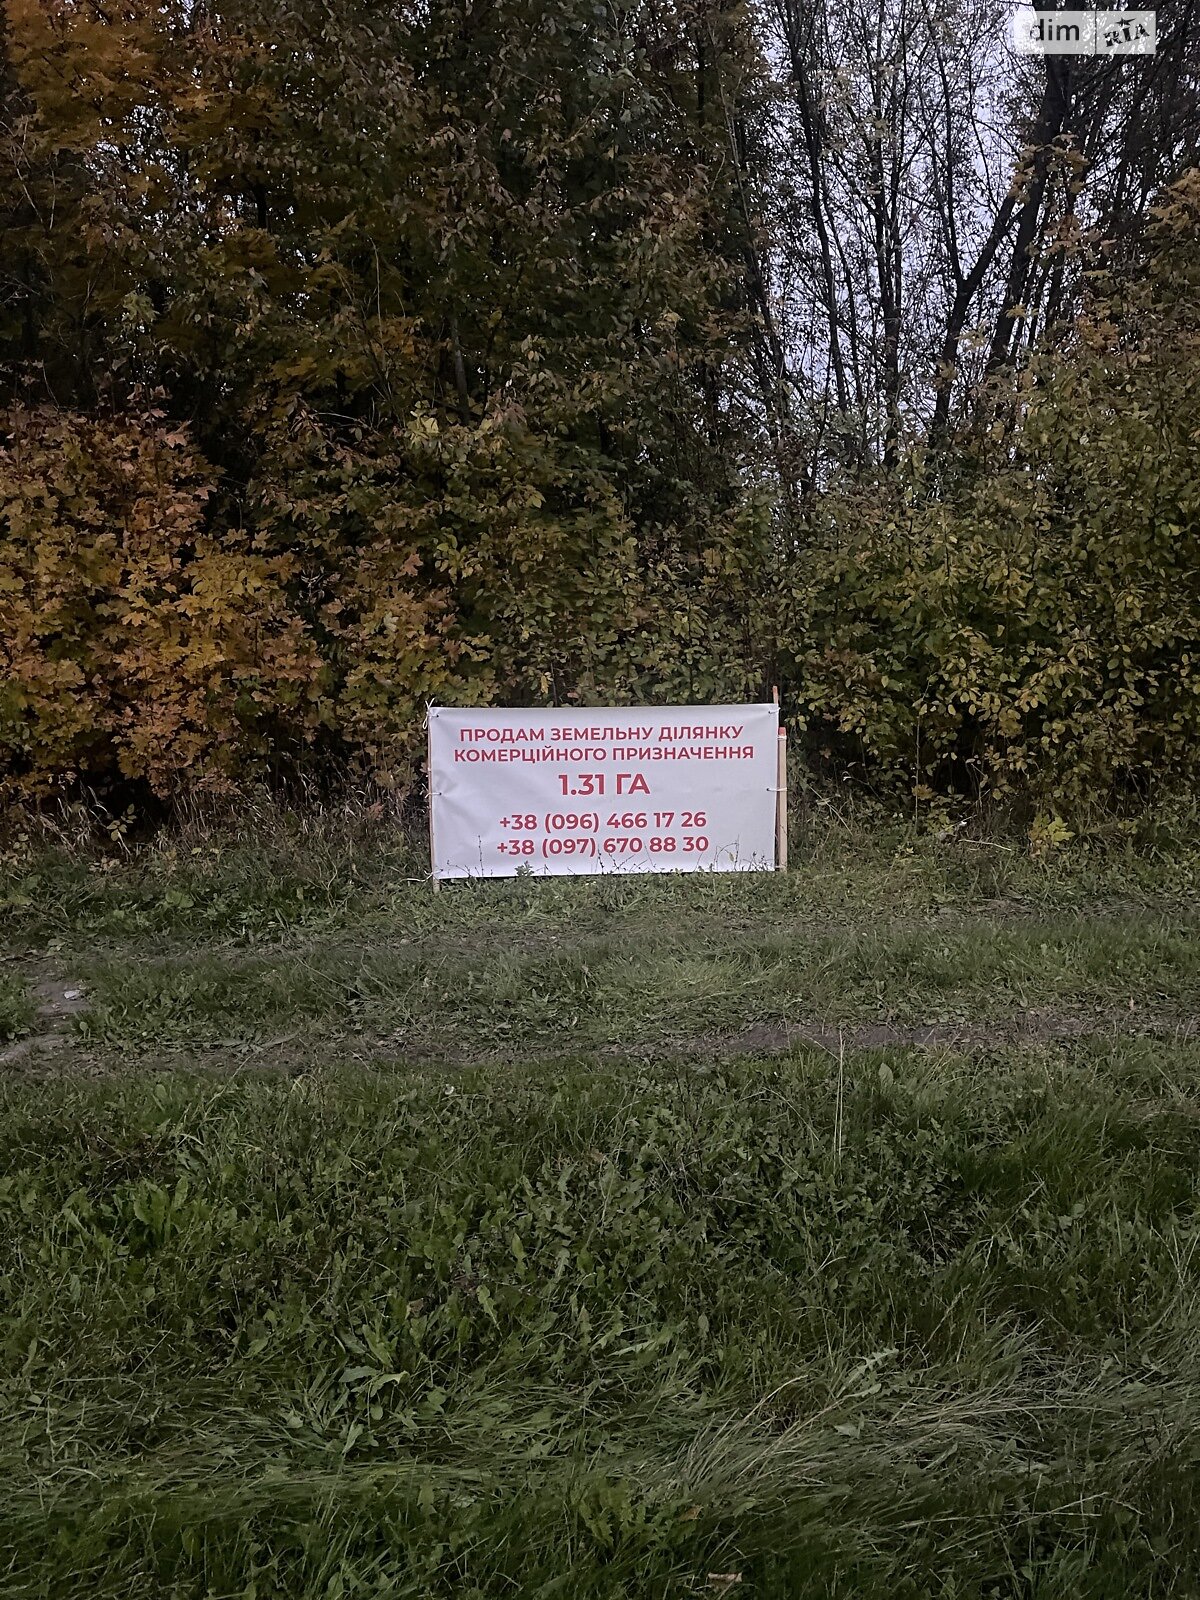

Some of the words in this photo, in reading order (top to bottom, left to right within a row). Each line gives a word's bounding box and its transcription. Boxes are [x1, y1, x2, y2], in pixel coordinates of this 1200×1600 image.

[459, 727, 545, 744] ПРОДАМ
[550, 726, 654, 742] ЗЕМЕЛЬНУ
[658, 725, 744, 743] ДІЛЯНКУ
[453, 745, 607, 764] КОМЕРЦІЙНОГО
[612, 745, 755, 761] ПРИЗНАЧЕННЯ
[558, 773, 605, 796] 1.31
[615, 772, 651, 796] ГА
[499, 814, 538, 831] +38
[544, 812, 600, 834] (096)
[606, 812, 648, 830] 466
[653, 811, 676, 829] 17
[681, 811, 708, 829] 26
[497, 838, 536, 857] +38
[541, 837, 597, 858] (097)
[603, 837, 644, 855] 670
[649, 836, 677, 854] 88
[682, 836, 710, 853] 30
